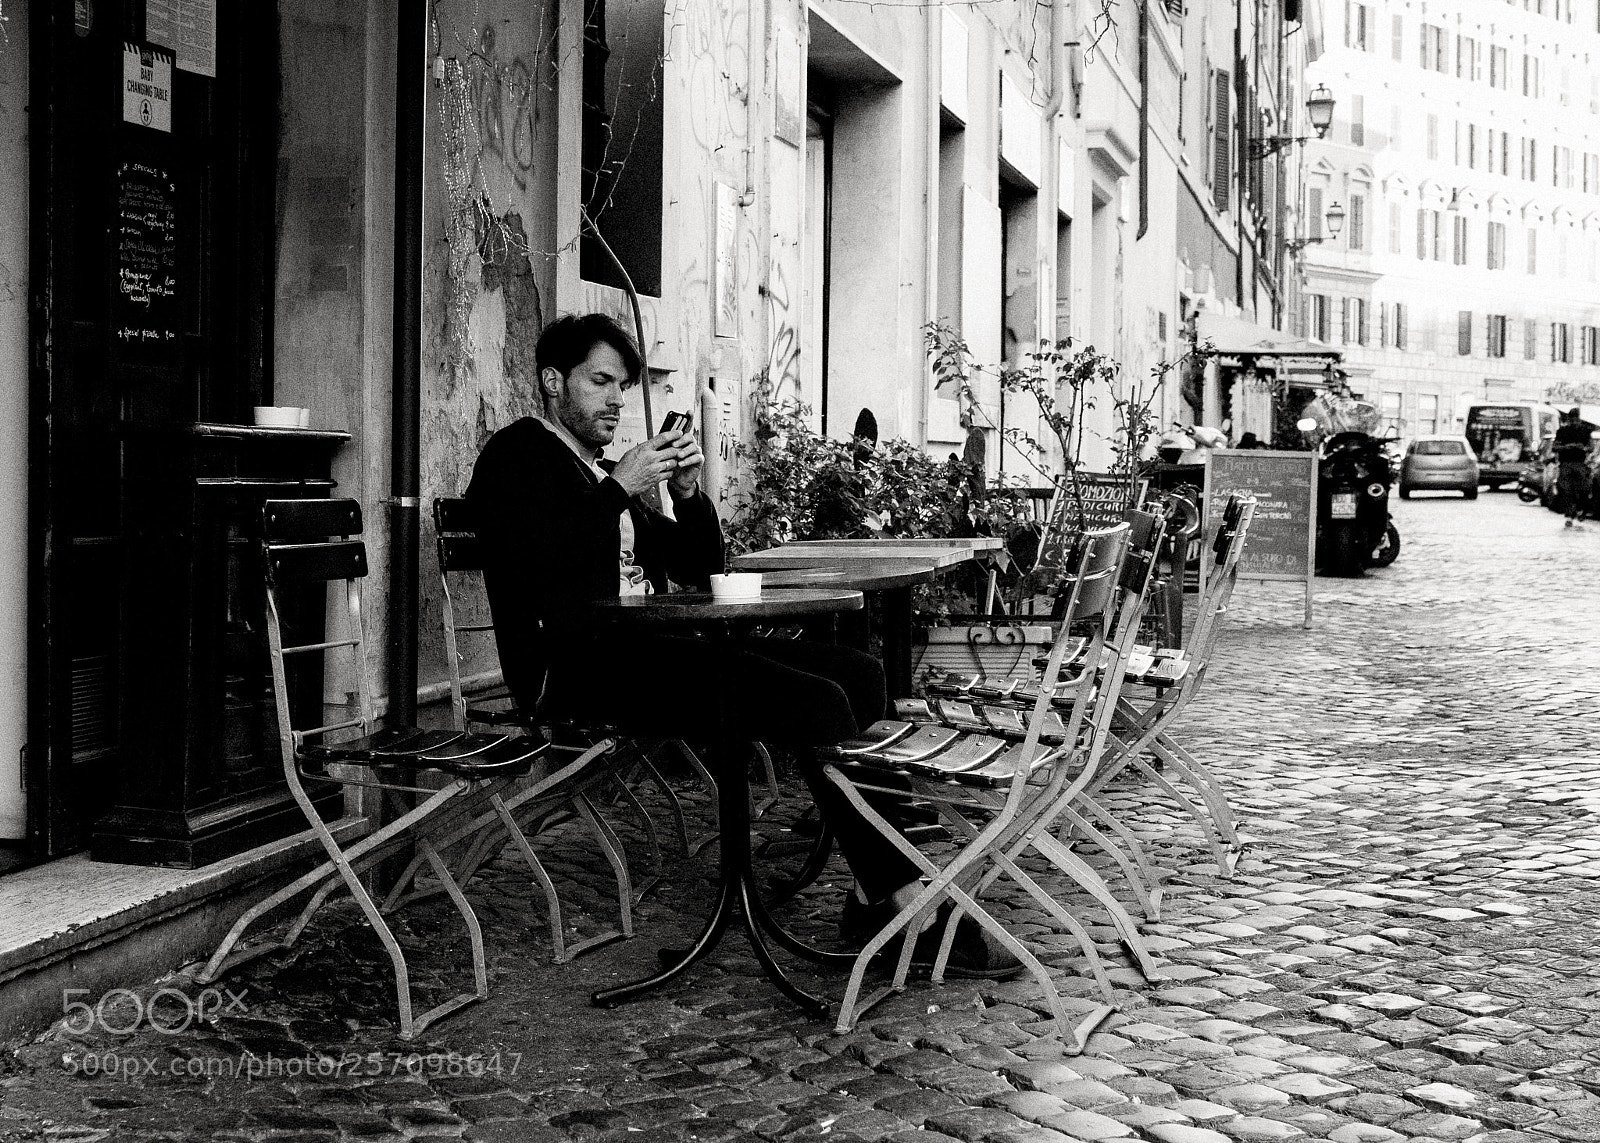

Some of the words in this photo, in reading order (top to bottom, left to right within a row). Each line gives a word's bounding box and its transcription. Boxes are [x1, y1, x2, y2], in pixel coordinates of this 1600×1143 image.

[140, 67, 153, 82] BABY
[127, 79, 153, 98] CHANGING
[153, 87, 168, 101] TABLE
